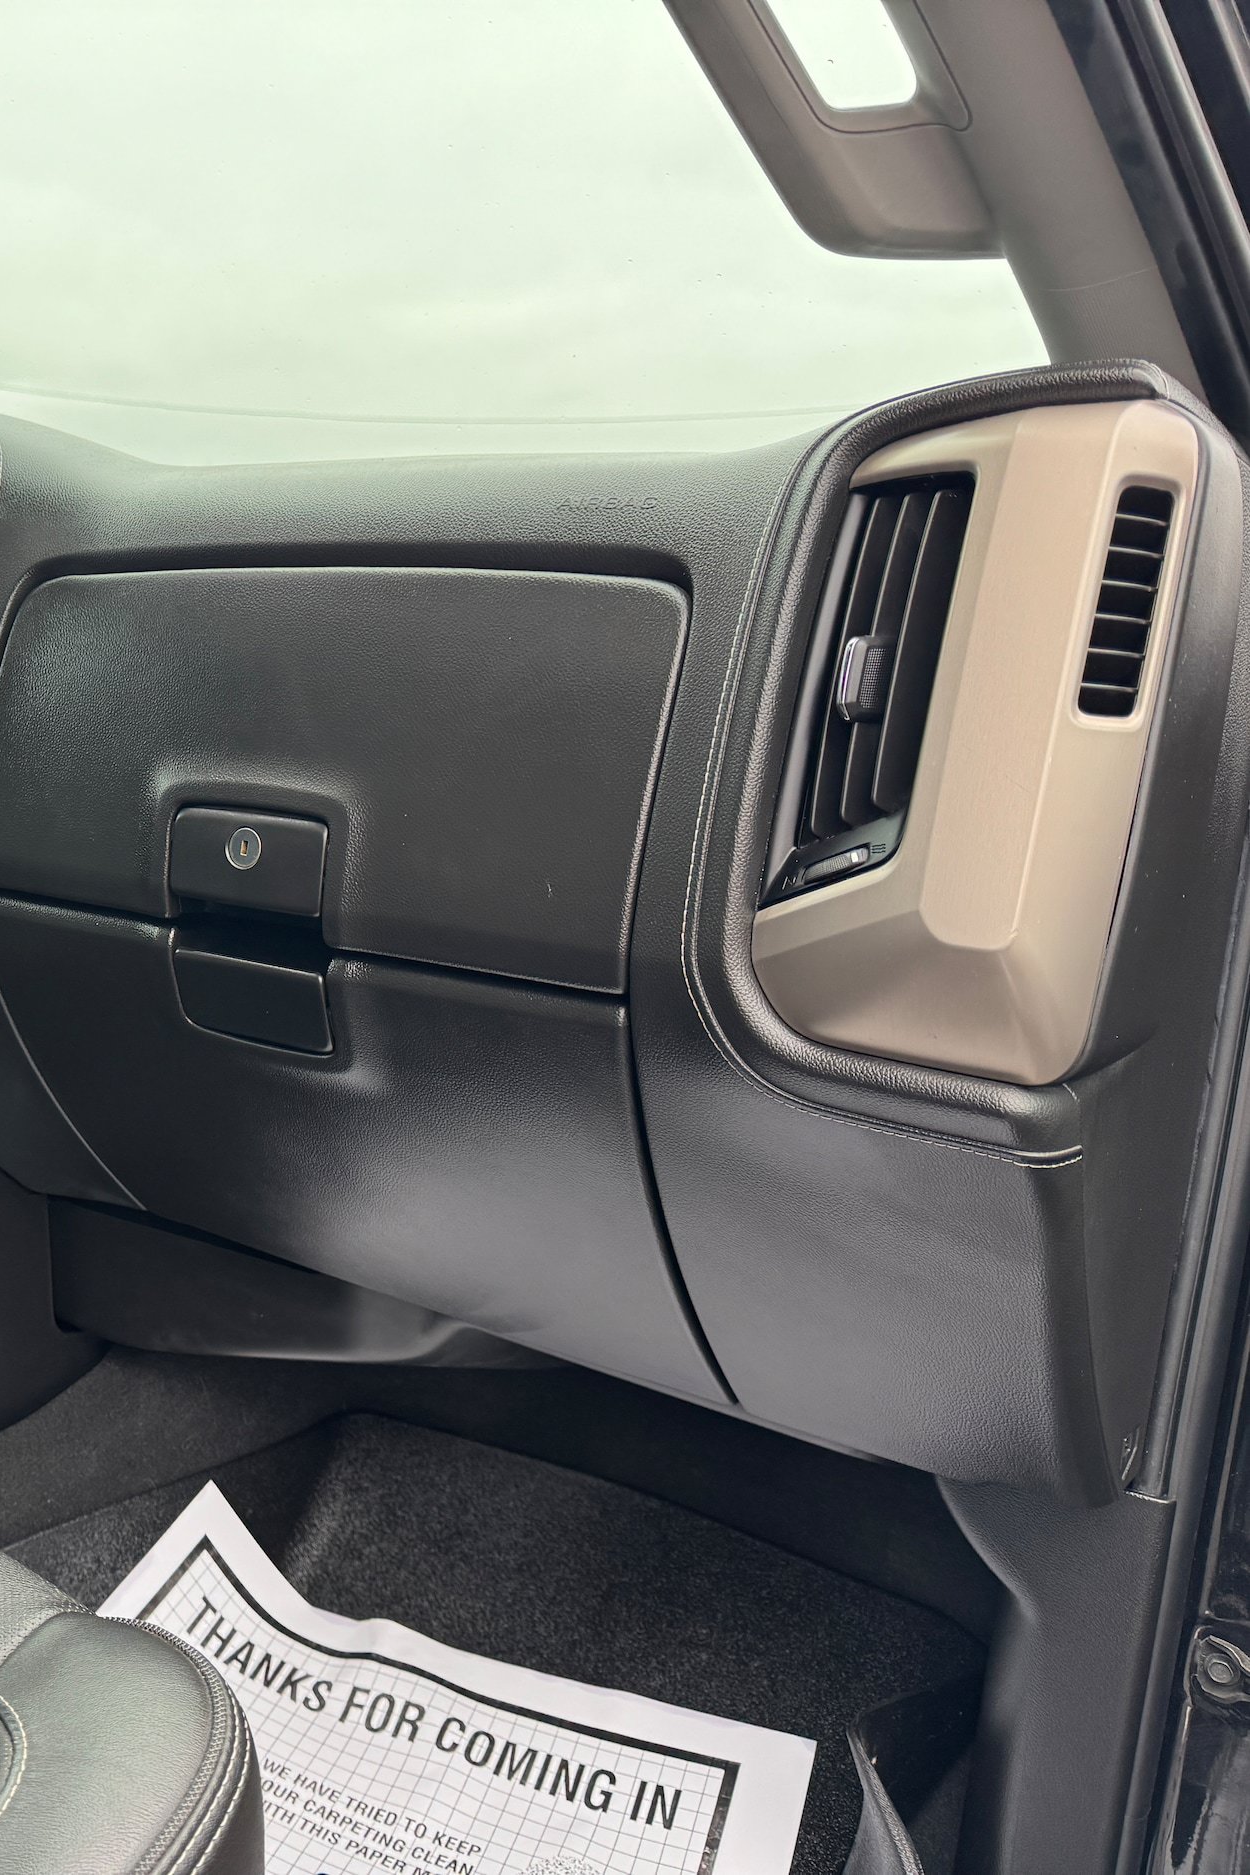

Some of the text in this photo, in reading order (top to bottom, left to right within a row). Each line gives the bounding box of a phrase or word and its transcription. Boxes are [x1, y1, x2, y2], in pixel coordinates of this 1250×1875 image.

[556, 496, 659, 510] AIRBAG
[186, 1597, 682, 1831] THANKS FOR COMING IN
[260, 1776, 475, 1875] OUR CARPETING CLEAN
[262, 1757, 482, 1858] WE HAVE TRIED TO KEEP
[299, 1816, 342, 1845] THIS
[345, 1839, 408, 1874] PAPER
